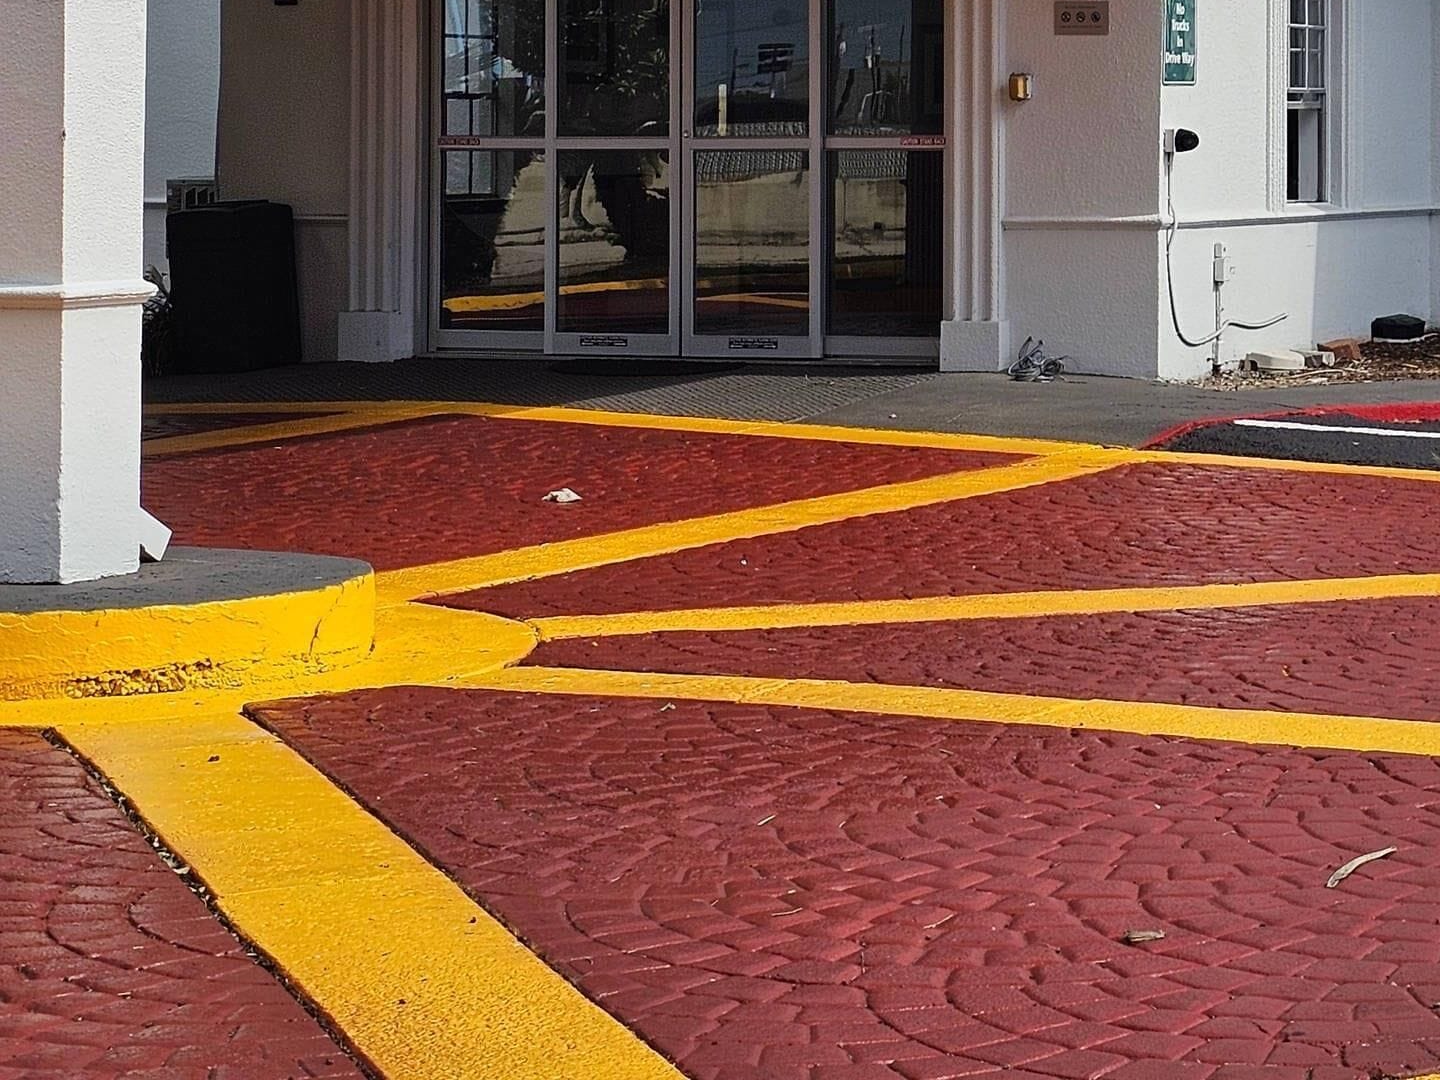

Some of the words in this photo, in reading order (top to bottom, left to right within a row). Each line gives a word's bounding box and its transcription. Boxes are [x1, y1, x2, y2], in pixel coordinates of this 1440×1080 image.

[1176, 3, 1185, 15] No
[1171, 19, 1190, 31] Trucks
[1165, 51, 1181, 64] Drive
[1182, 52, 1195, 67] Way
